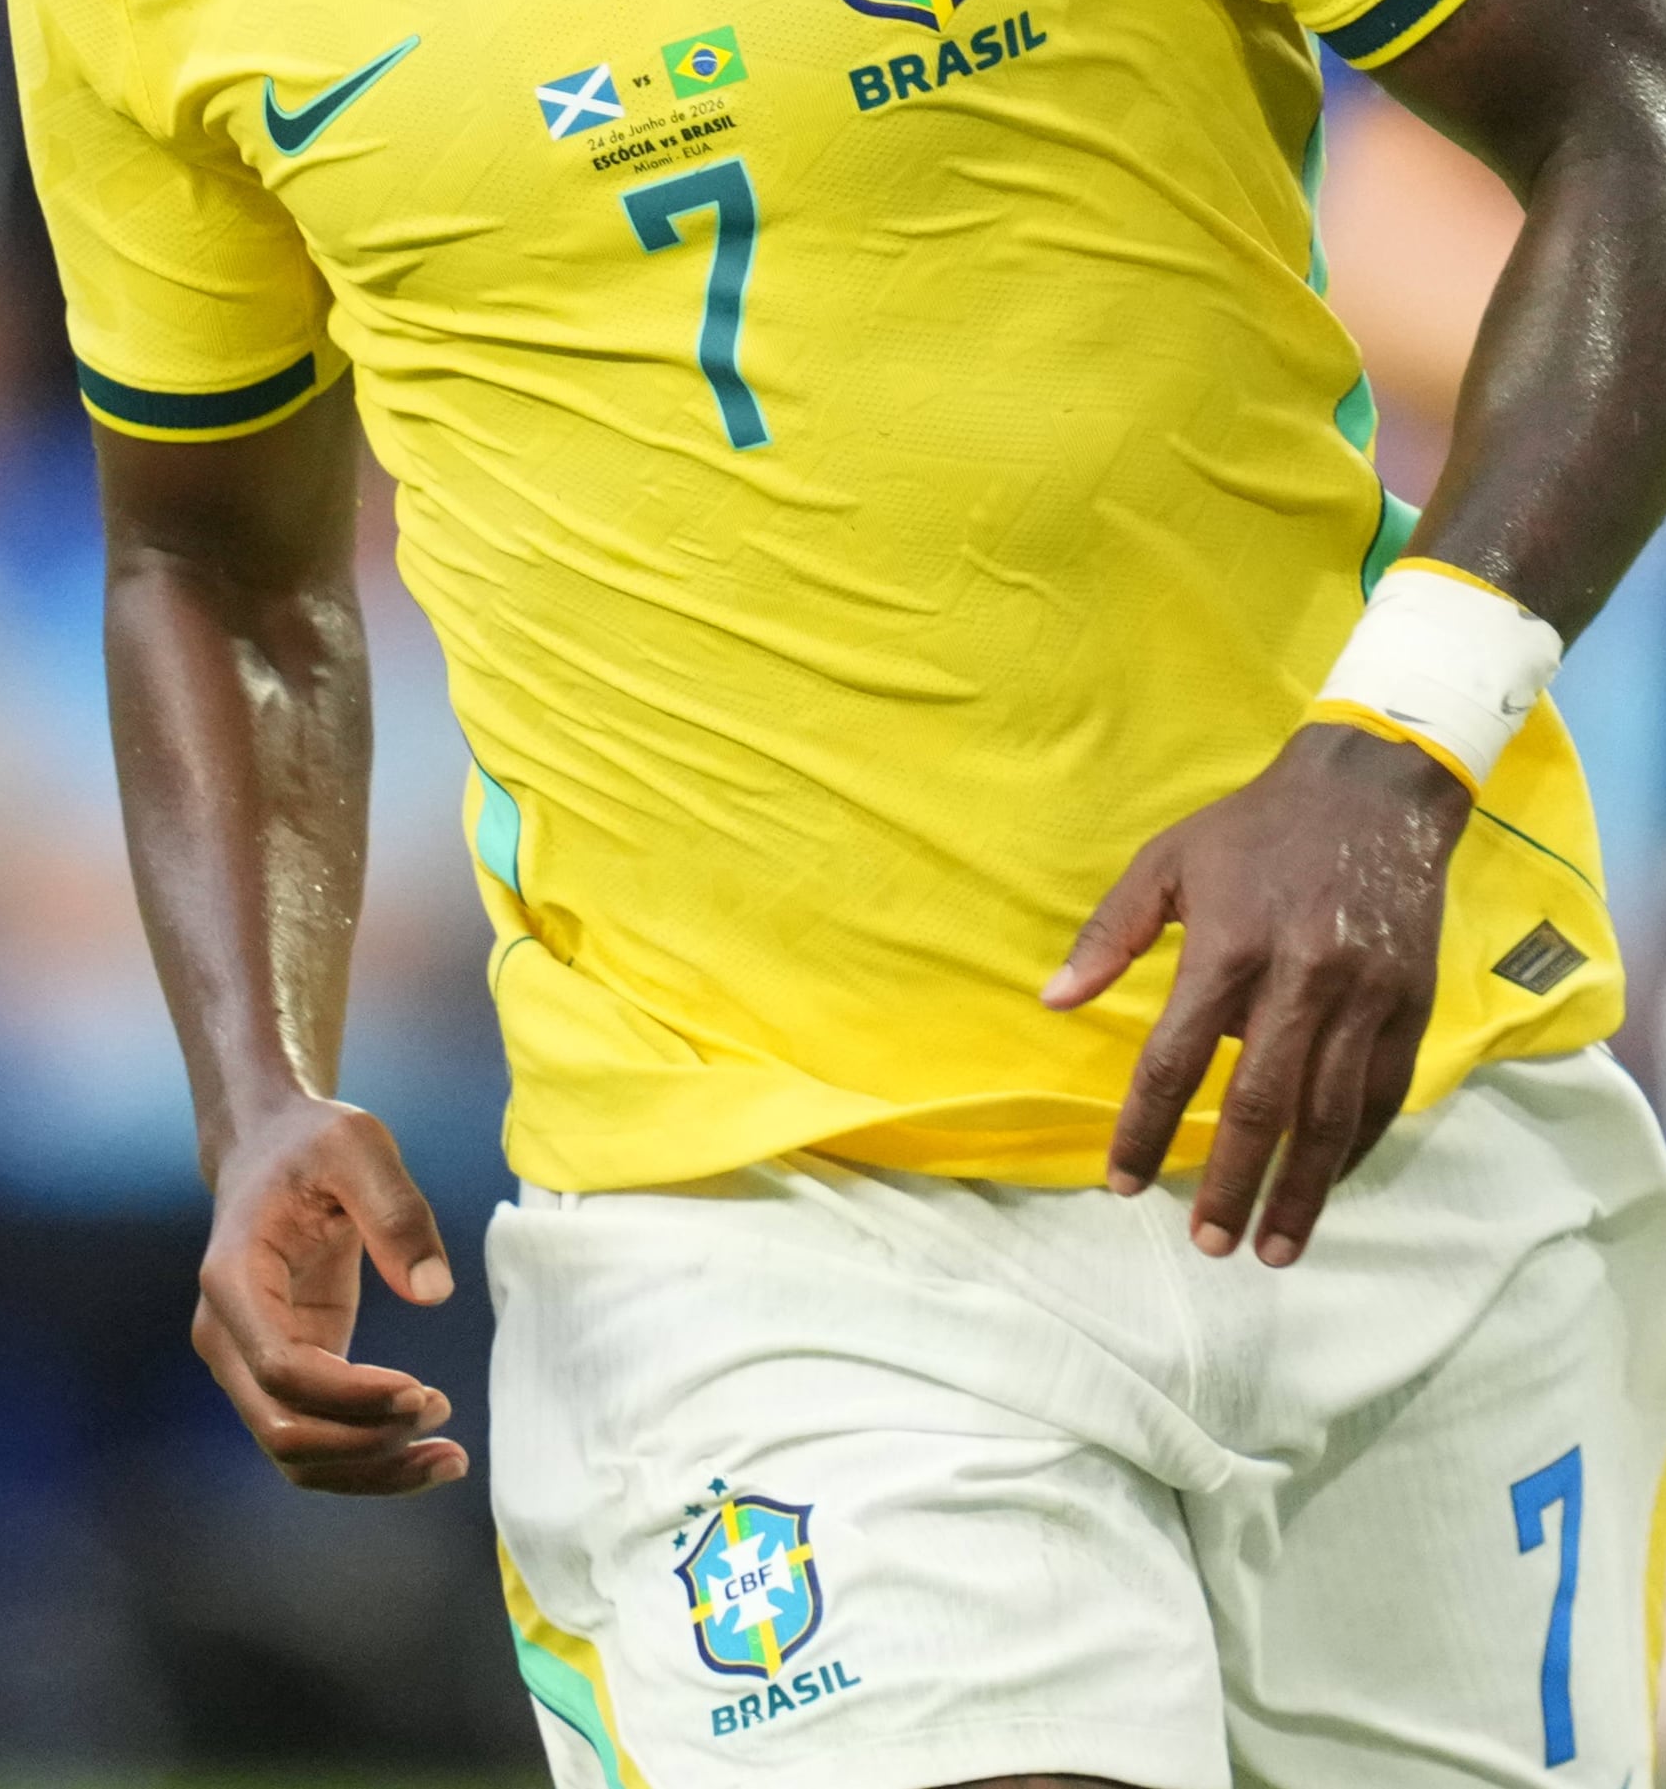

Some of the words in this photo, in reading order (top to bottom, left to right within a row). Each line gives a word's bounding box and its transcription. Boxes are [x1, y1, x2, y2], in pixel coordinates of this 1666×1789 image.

[632, 74, 651, 88] vs
[848, 10, 1047, 112] BRASIL
[587, 137, 605, 151] 24
[609, 130, 625, 144] de
[628, 117, 666, 137] Junho
[670, 109, 685, 124] de
[689, 98, 725, 118] 2026
[592, 139, 656, 171] ESCÓCIA
[659, 135, 678, 148] vs
[680, 115, 737, 142] BRASIL
[683, 142, 713, 159] EUA
[619, 155, 773, 452] 7
[724, 1562, 775, 1601] CBF
[1509, 1442, 1583, 1770] 7
[710, 1660, 862, 1737] BRASIL
